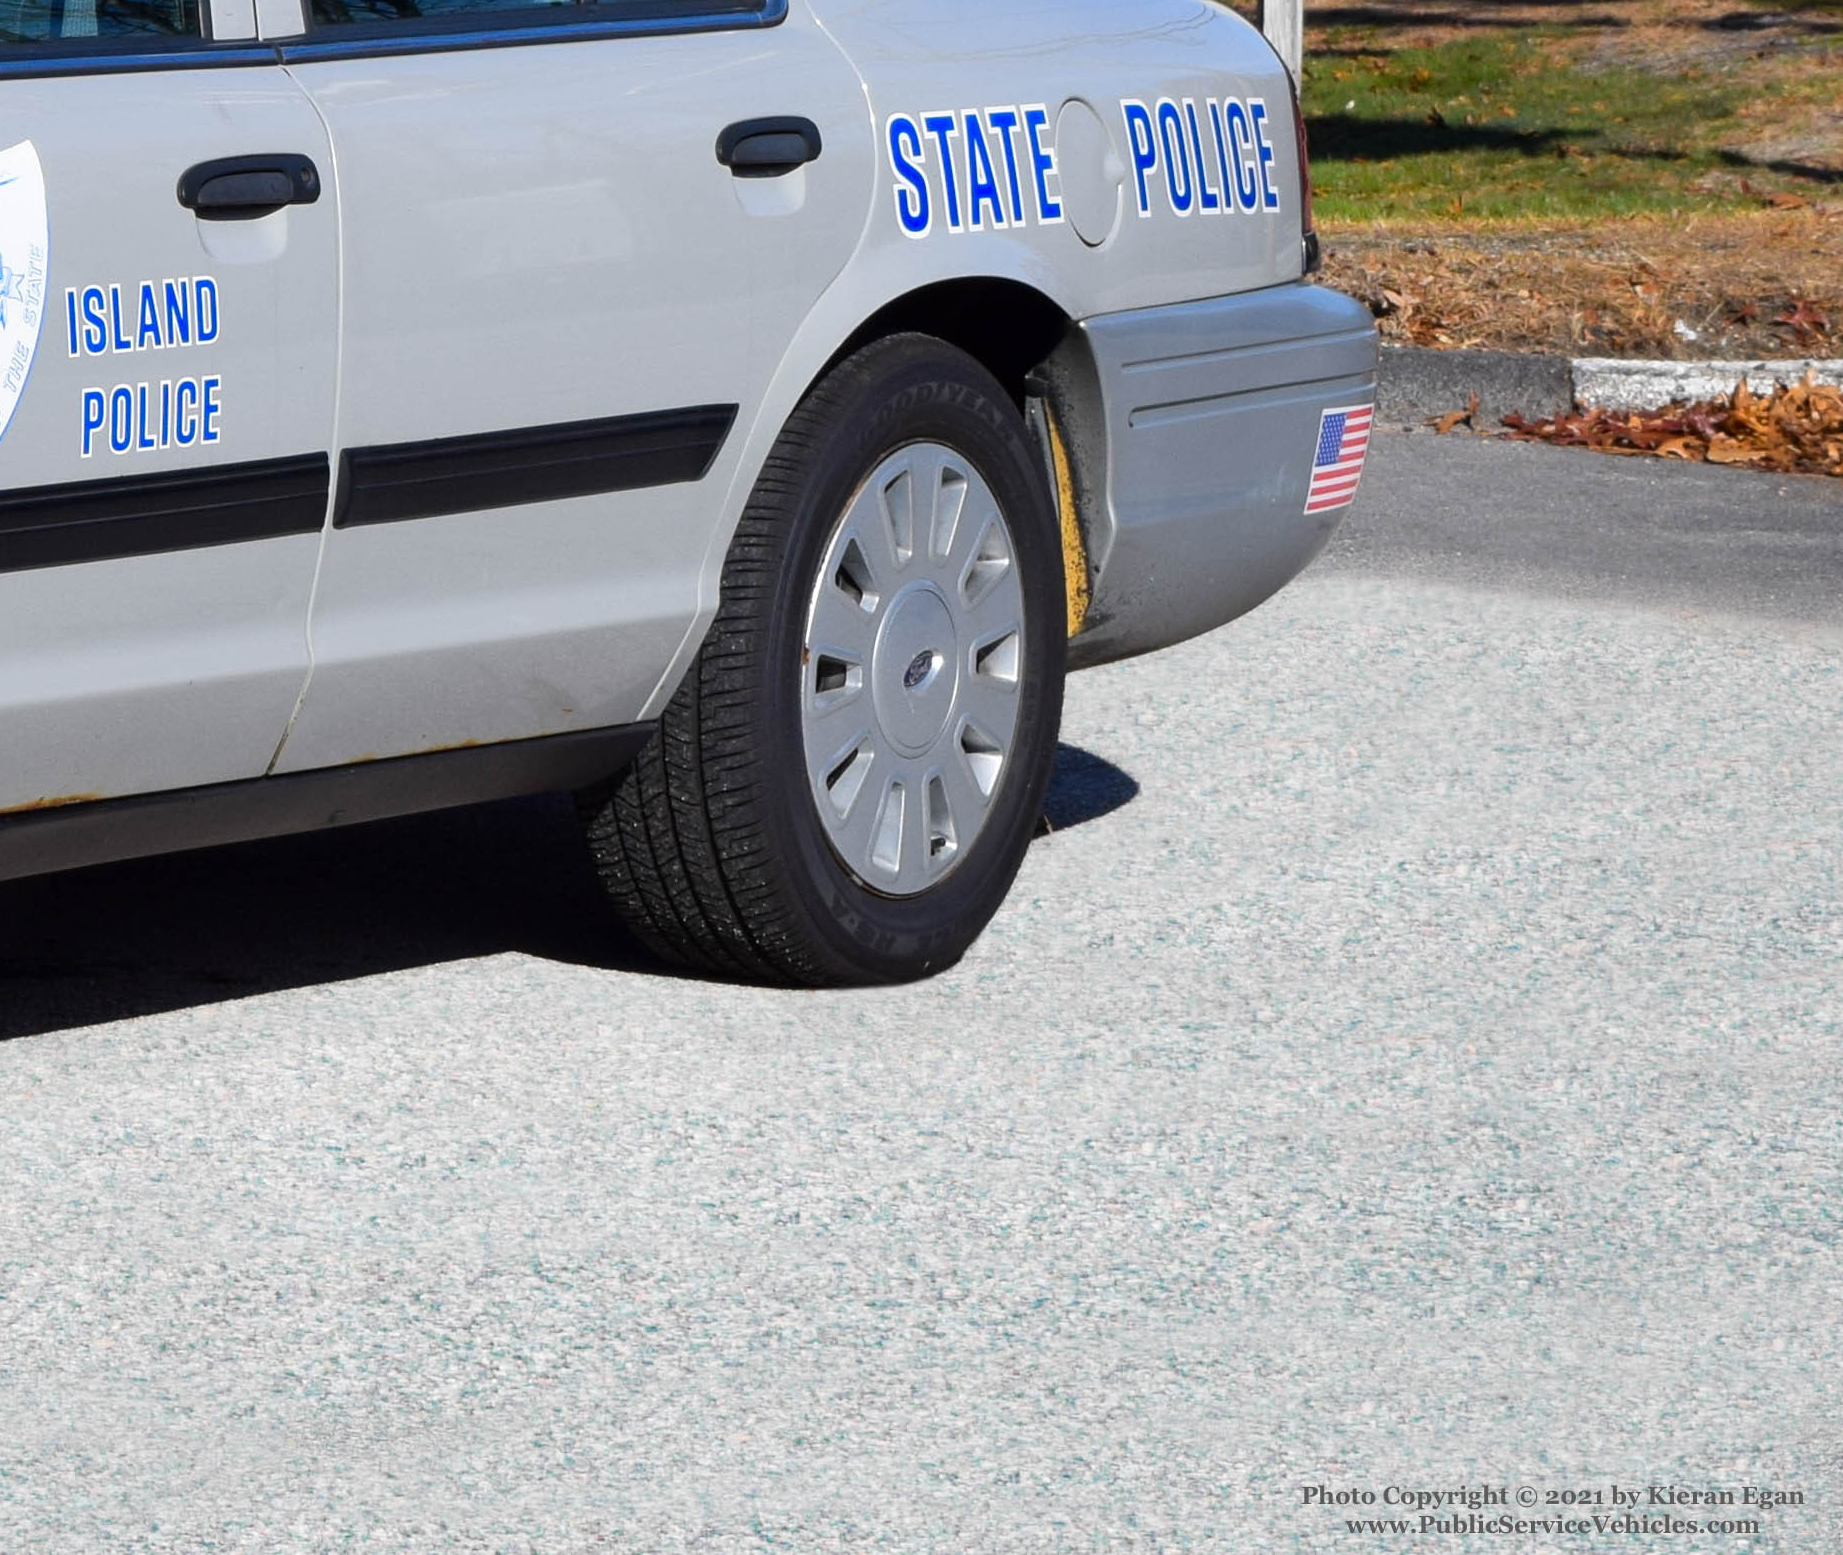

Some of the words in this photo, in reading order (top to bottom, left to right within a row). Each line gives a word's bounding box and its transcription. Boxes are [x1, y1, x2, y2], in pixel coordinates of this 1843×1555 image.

[886, 102, 1066, 239] STATE
[1120, 97, 1281, 218] POLICE
[3, 340, 31, 394] THE
[23, 242, 44, 327] STATE
[67, 277, 219, 356] ISLAND
[81, 376, 221, 457] POLICE
